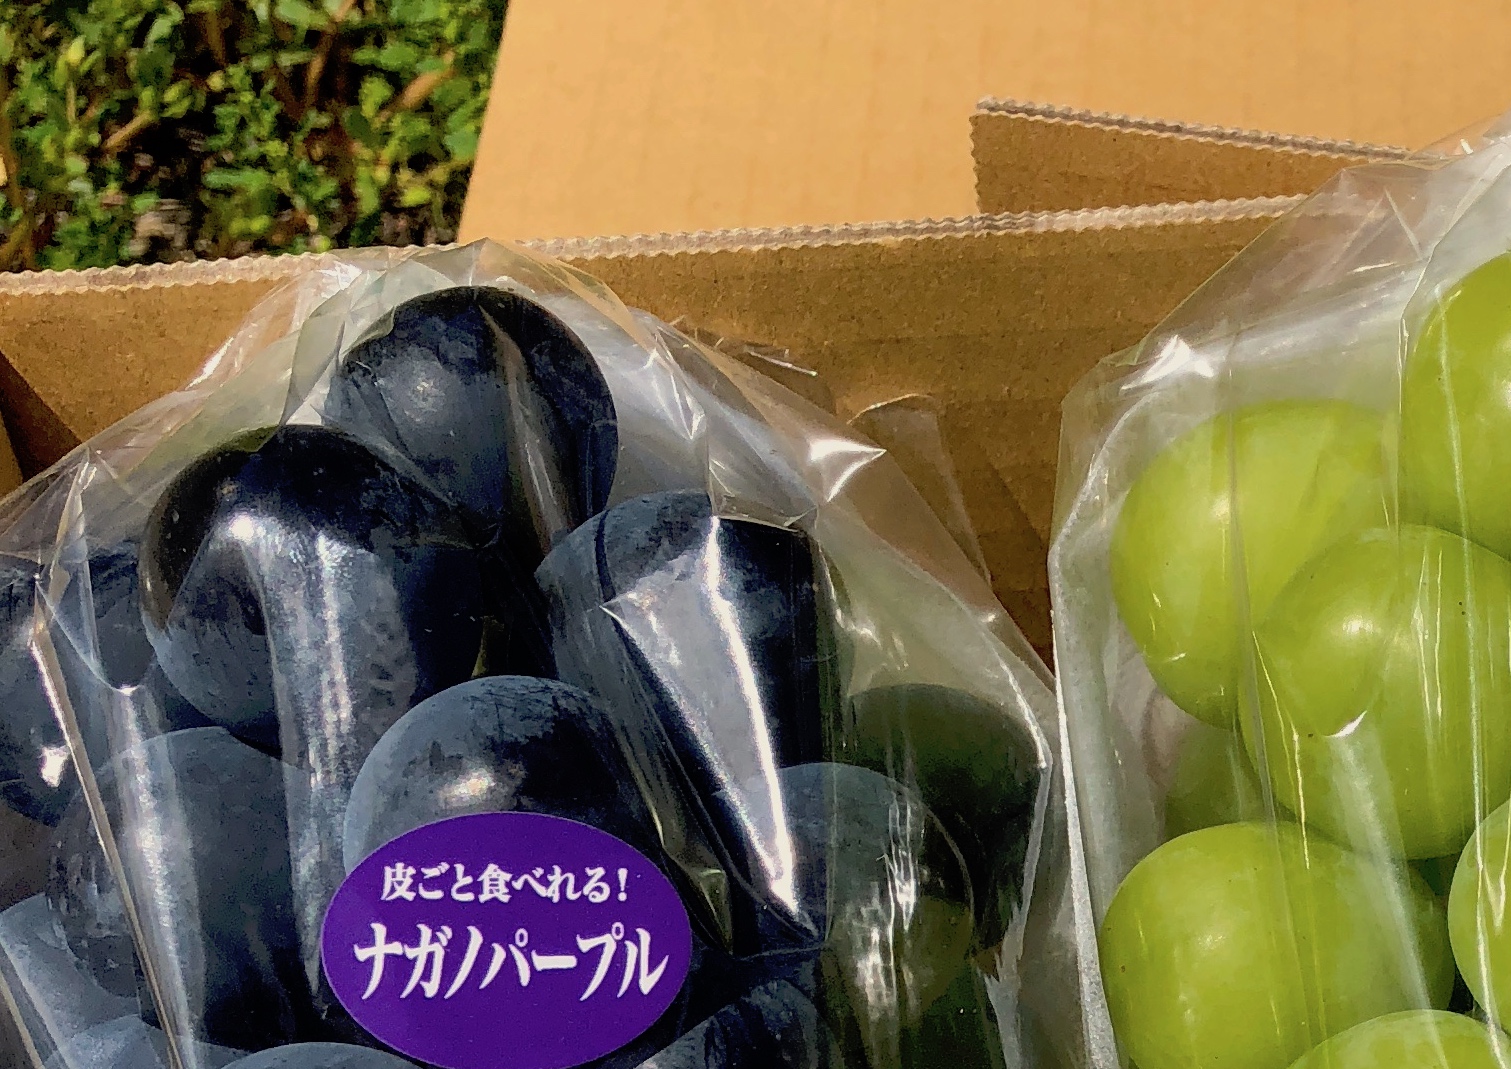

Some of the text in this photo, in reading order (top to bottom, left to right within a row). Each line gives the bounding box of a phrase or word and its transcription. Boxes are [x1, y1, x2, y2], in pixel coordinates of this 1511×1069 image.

[381, 861, 629, 903] 皮ごと食べれる！
[353, 922, 670, 1001] ナガノパープル
